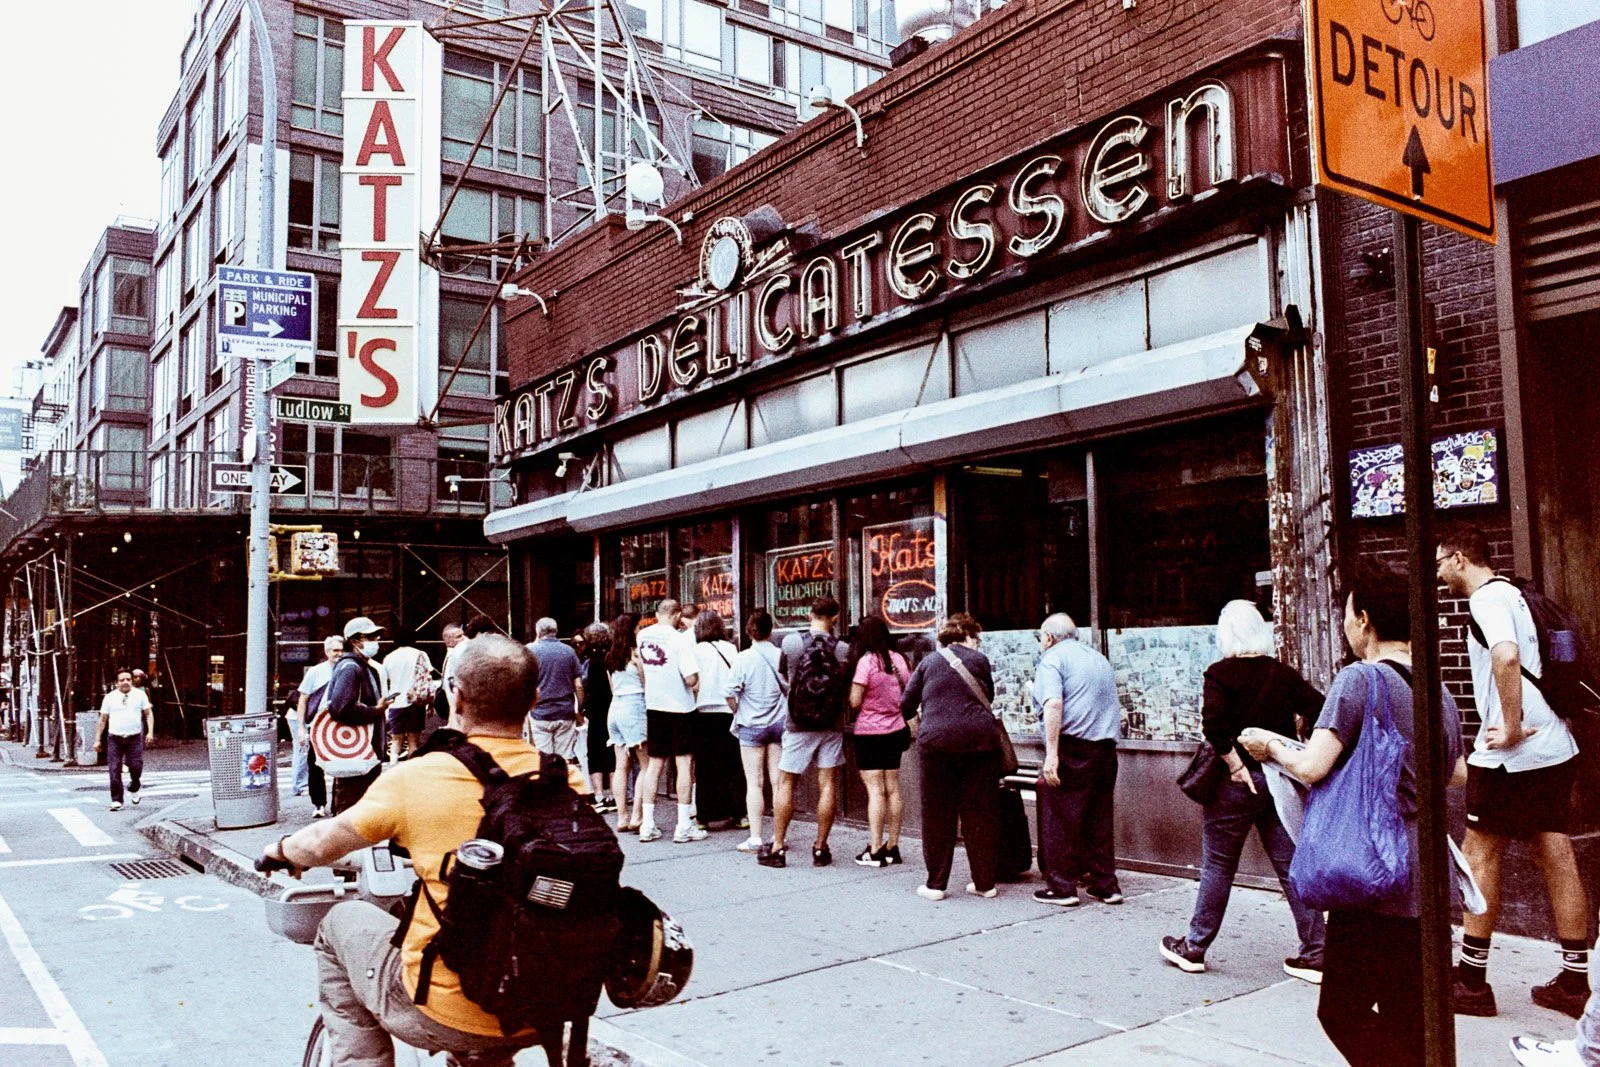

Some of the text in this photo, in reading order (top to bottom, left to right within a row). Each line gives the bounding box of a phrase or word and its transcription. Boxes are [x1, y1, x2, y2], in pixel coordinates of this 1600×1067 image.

[1329, 20, 1478, 143] DETOUR
[347, 26, 406, 409] KATZ'S
[226, 271, 304, 288] PARK & RIDE
[252, 290, 308, 306] MUNICIPAL
[224, 301, 246, 326] P
[252, 303, 298, 317] PARKING
[277, 400, 349, 420] Ludlow St
[221, 472, 288, 486] ONE AY
